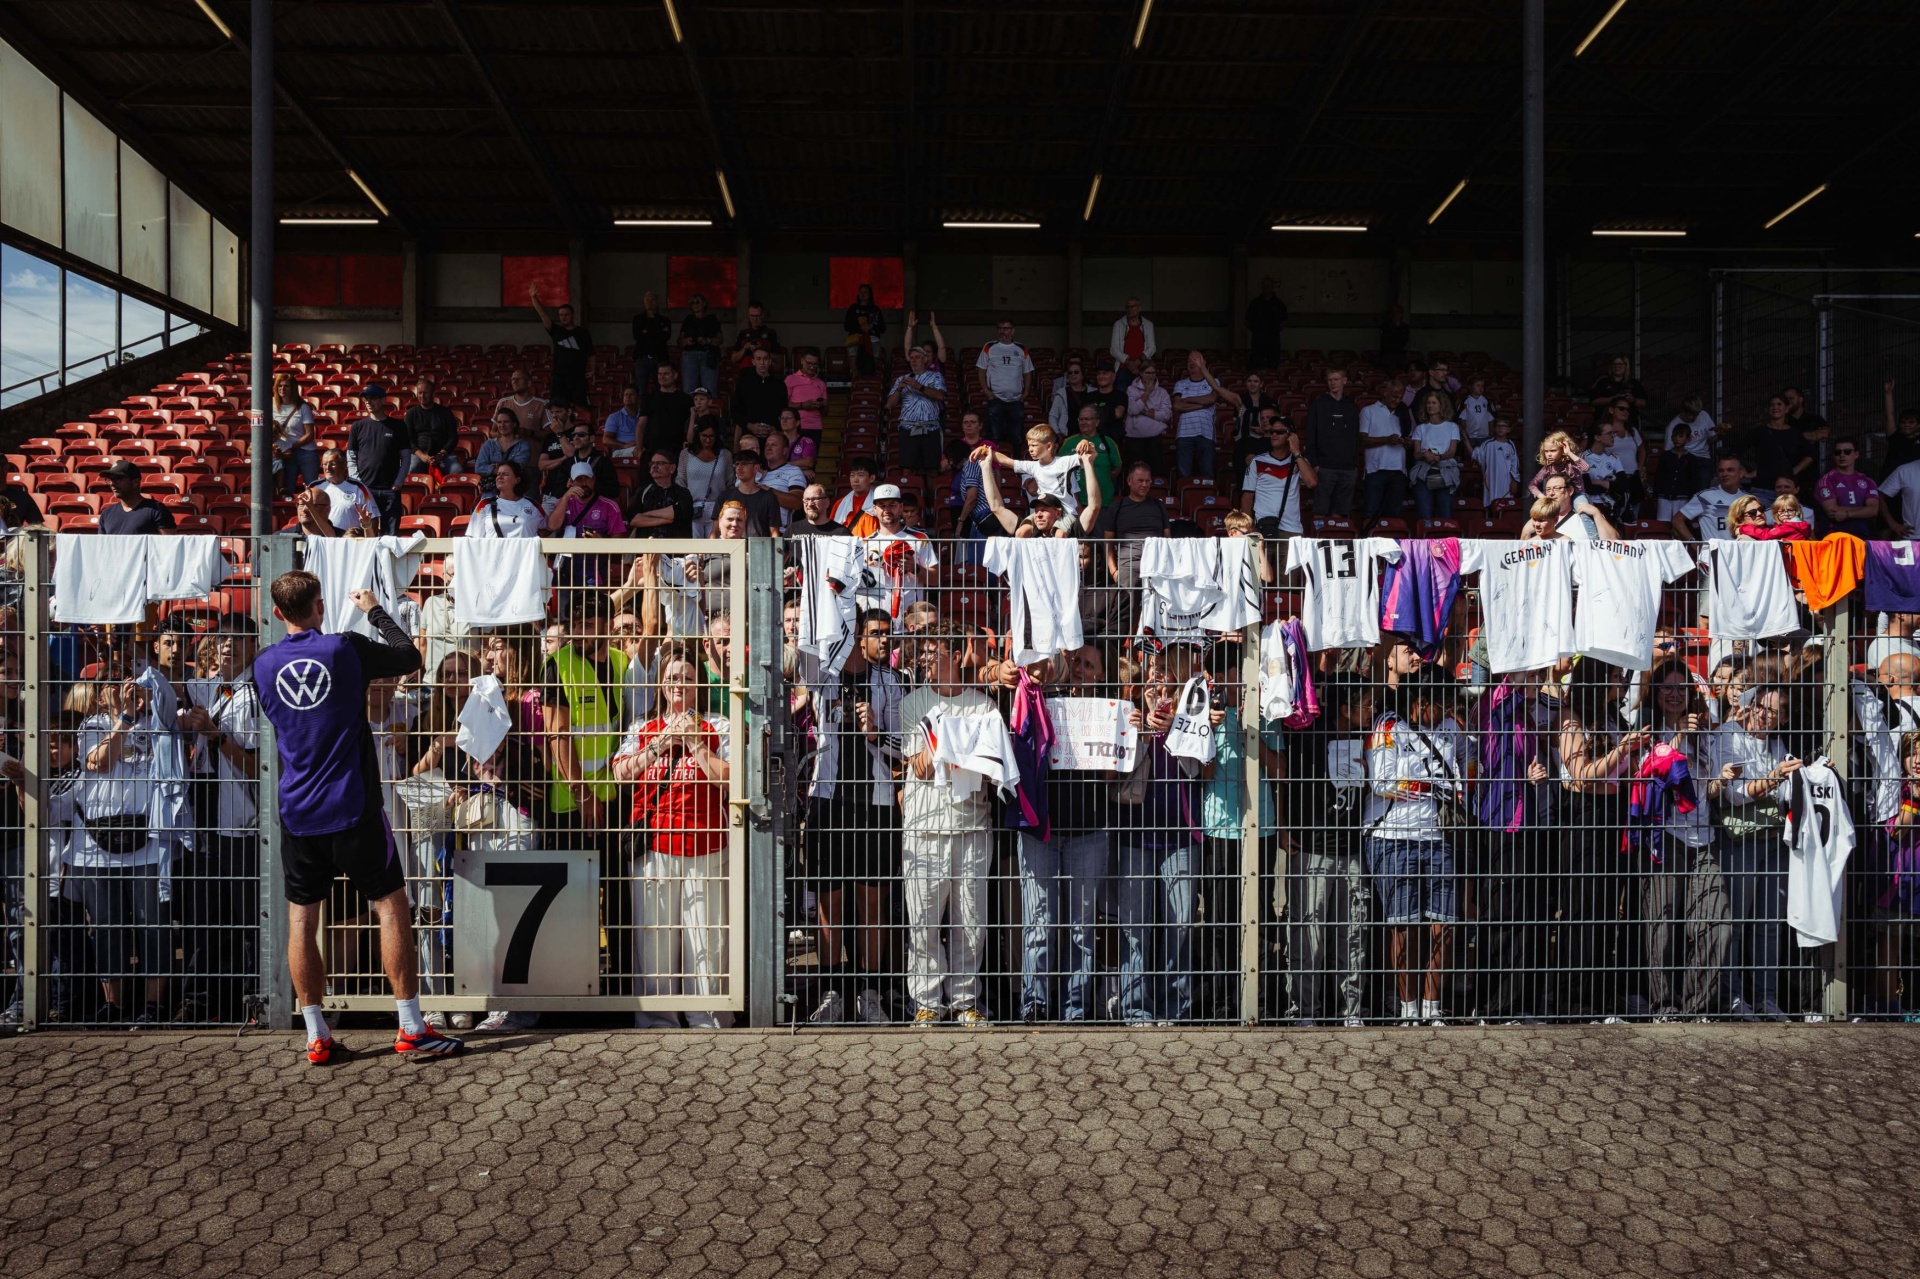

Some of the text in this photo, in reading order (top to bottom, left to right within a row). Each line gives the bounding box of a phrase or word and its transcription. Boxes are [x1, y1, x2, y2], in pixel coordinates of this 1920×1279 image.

[1002, 356, 1011, 364] 17
[1474, 405, 1482, 413] 13
[1848, 491, 1856, 504] 3
[1717, 516, 1726, 531] 6
[1317, 540, 1358, 579] 13
[1504, 543, 1552, 565] GERMANY
[1592, 540, 1644, 560] GERMANY
[277, 660, 329, 707] VW
[1084, 741, 1135, 761] TRIKOT
[485, 862, 568, 984] 7
